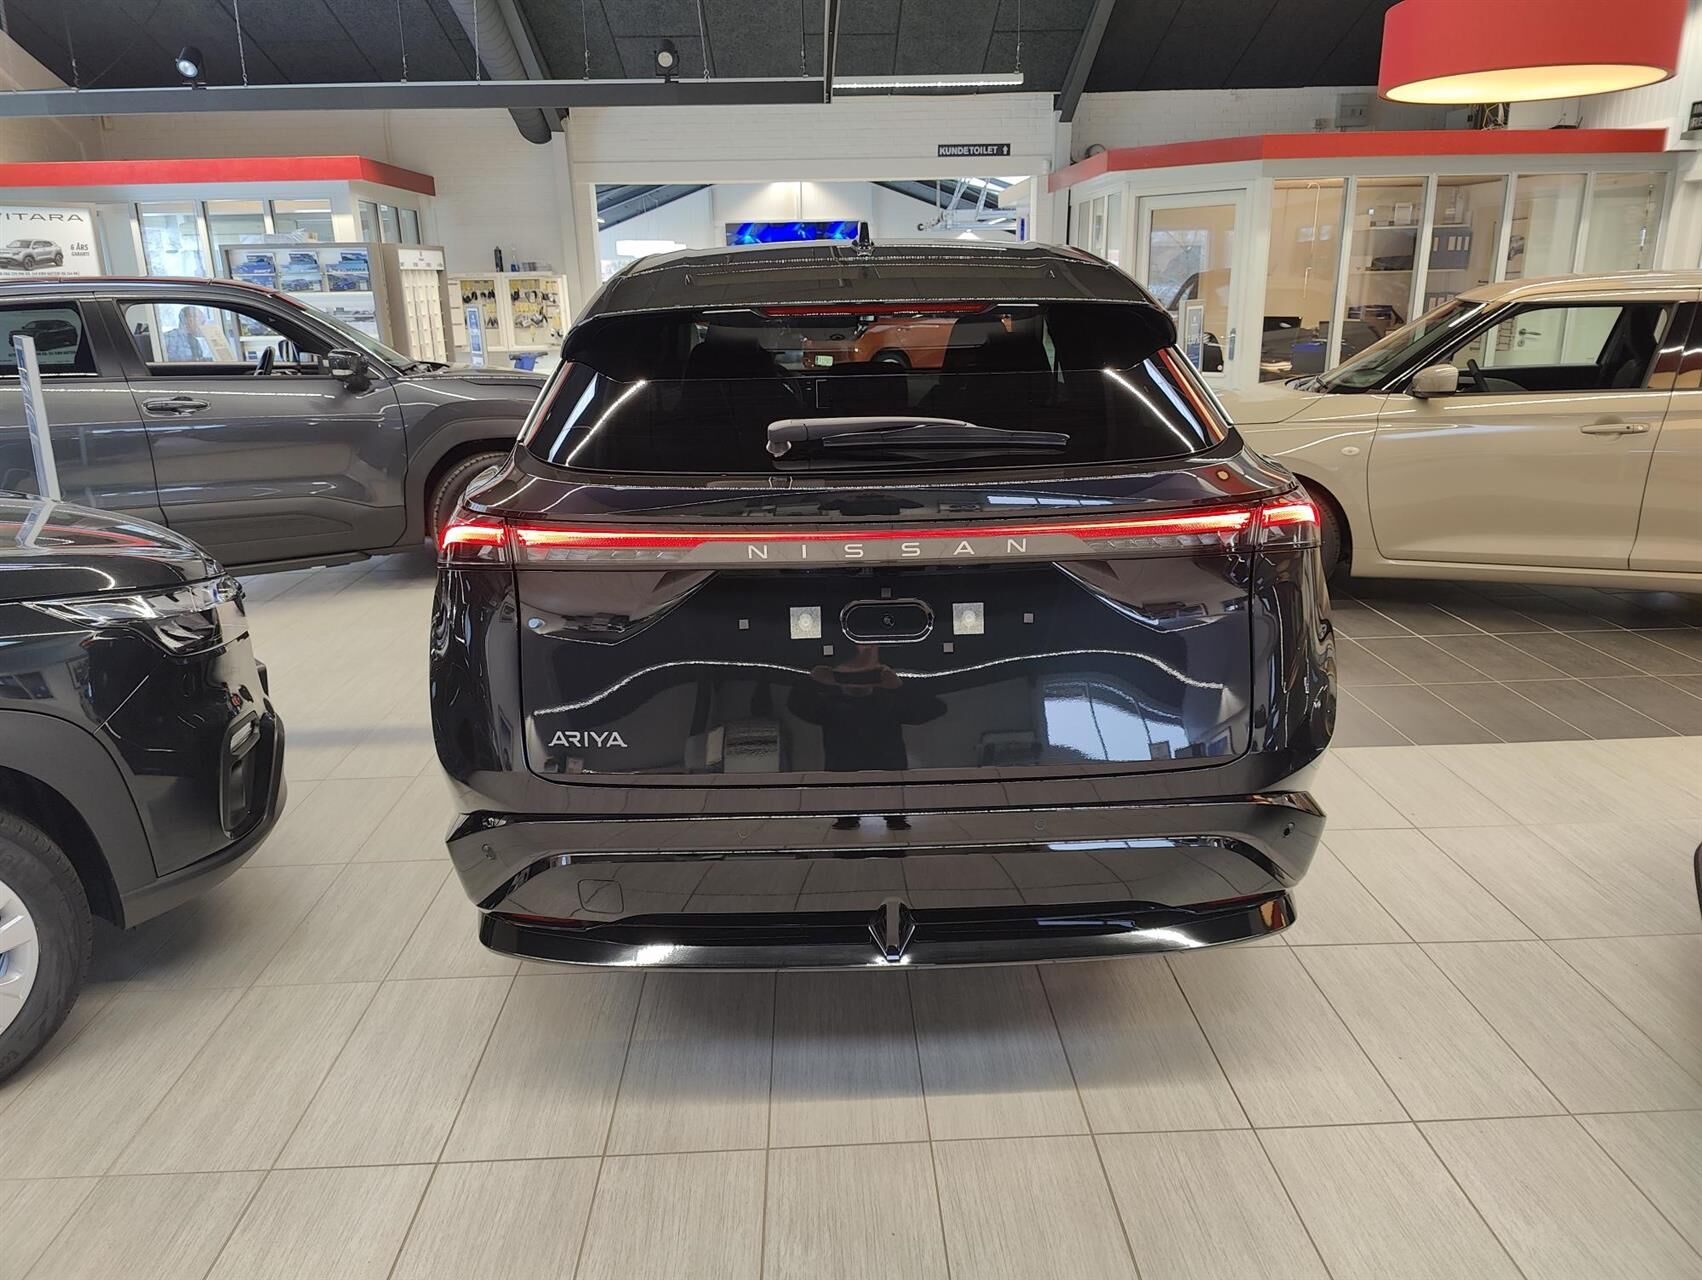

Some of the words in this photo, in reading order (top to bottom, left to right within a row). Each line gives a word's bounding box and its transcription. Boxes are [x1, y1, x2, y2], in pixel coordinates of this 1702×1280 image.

[939, 145, 998, 155] KUNDETOILET
[0, 212, 84, 222] ITARA
[748, 537, 1027, 559] NISSAN
[548, 731, 628, 748] ARIYA
